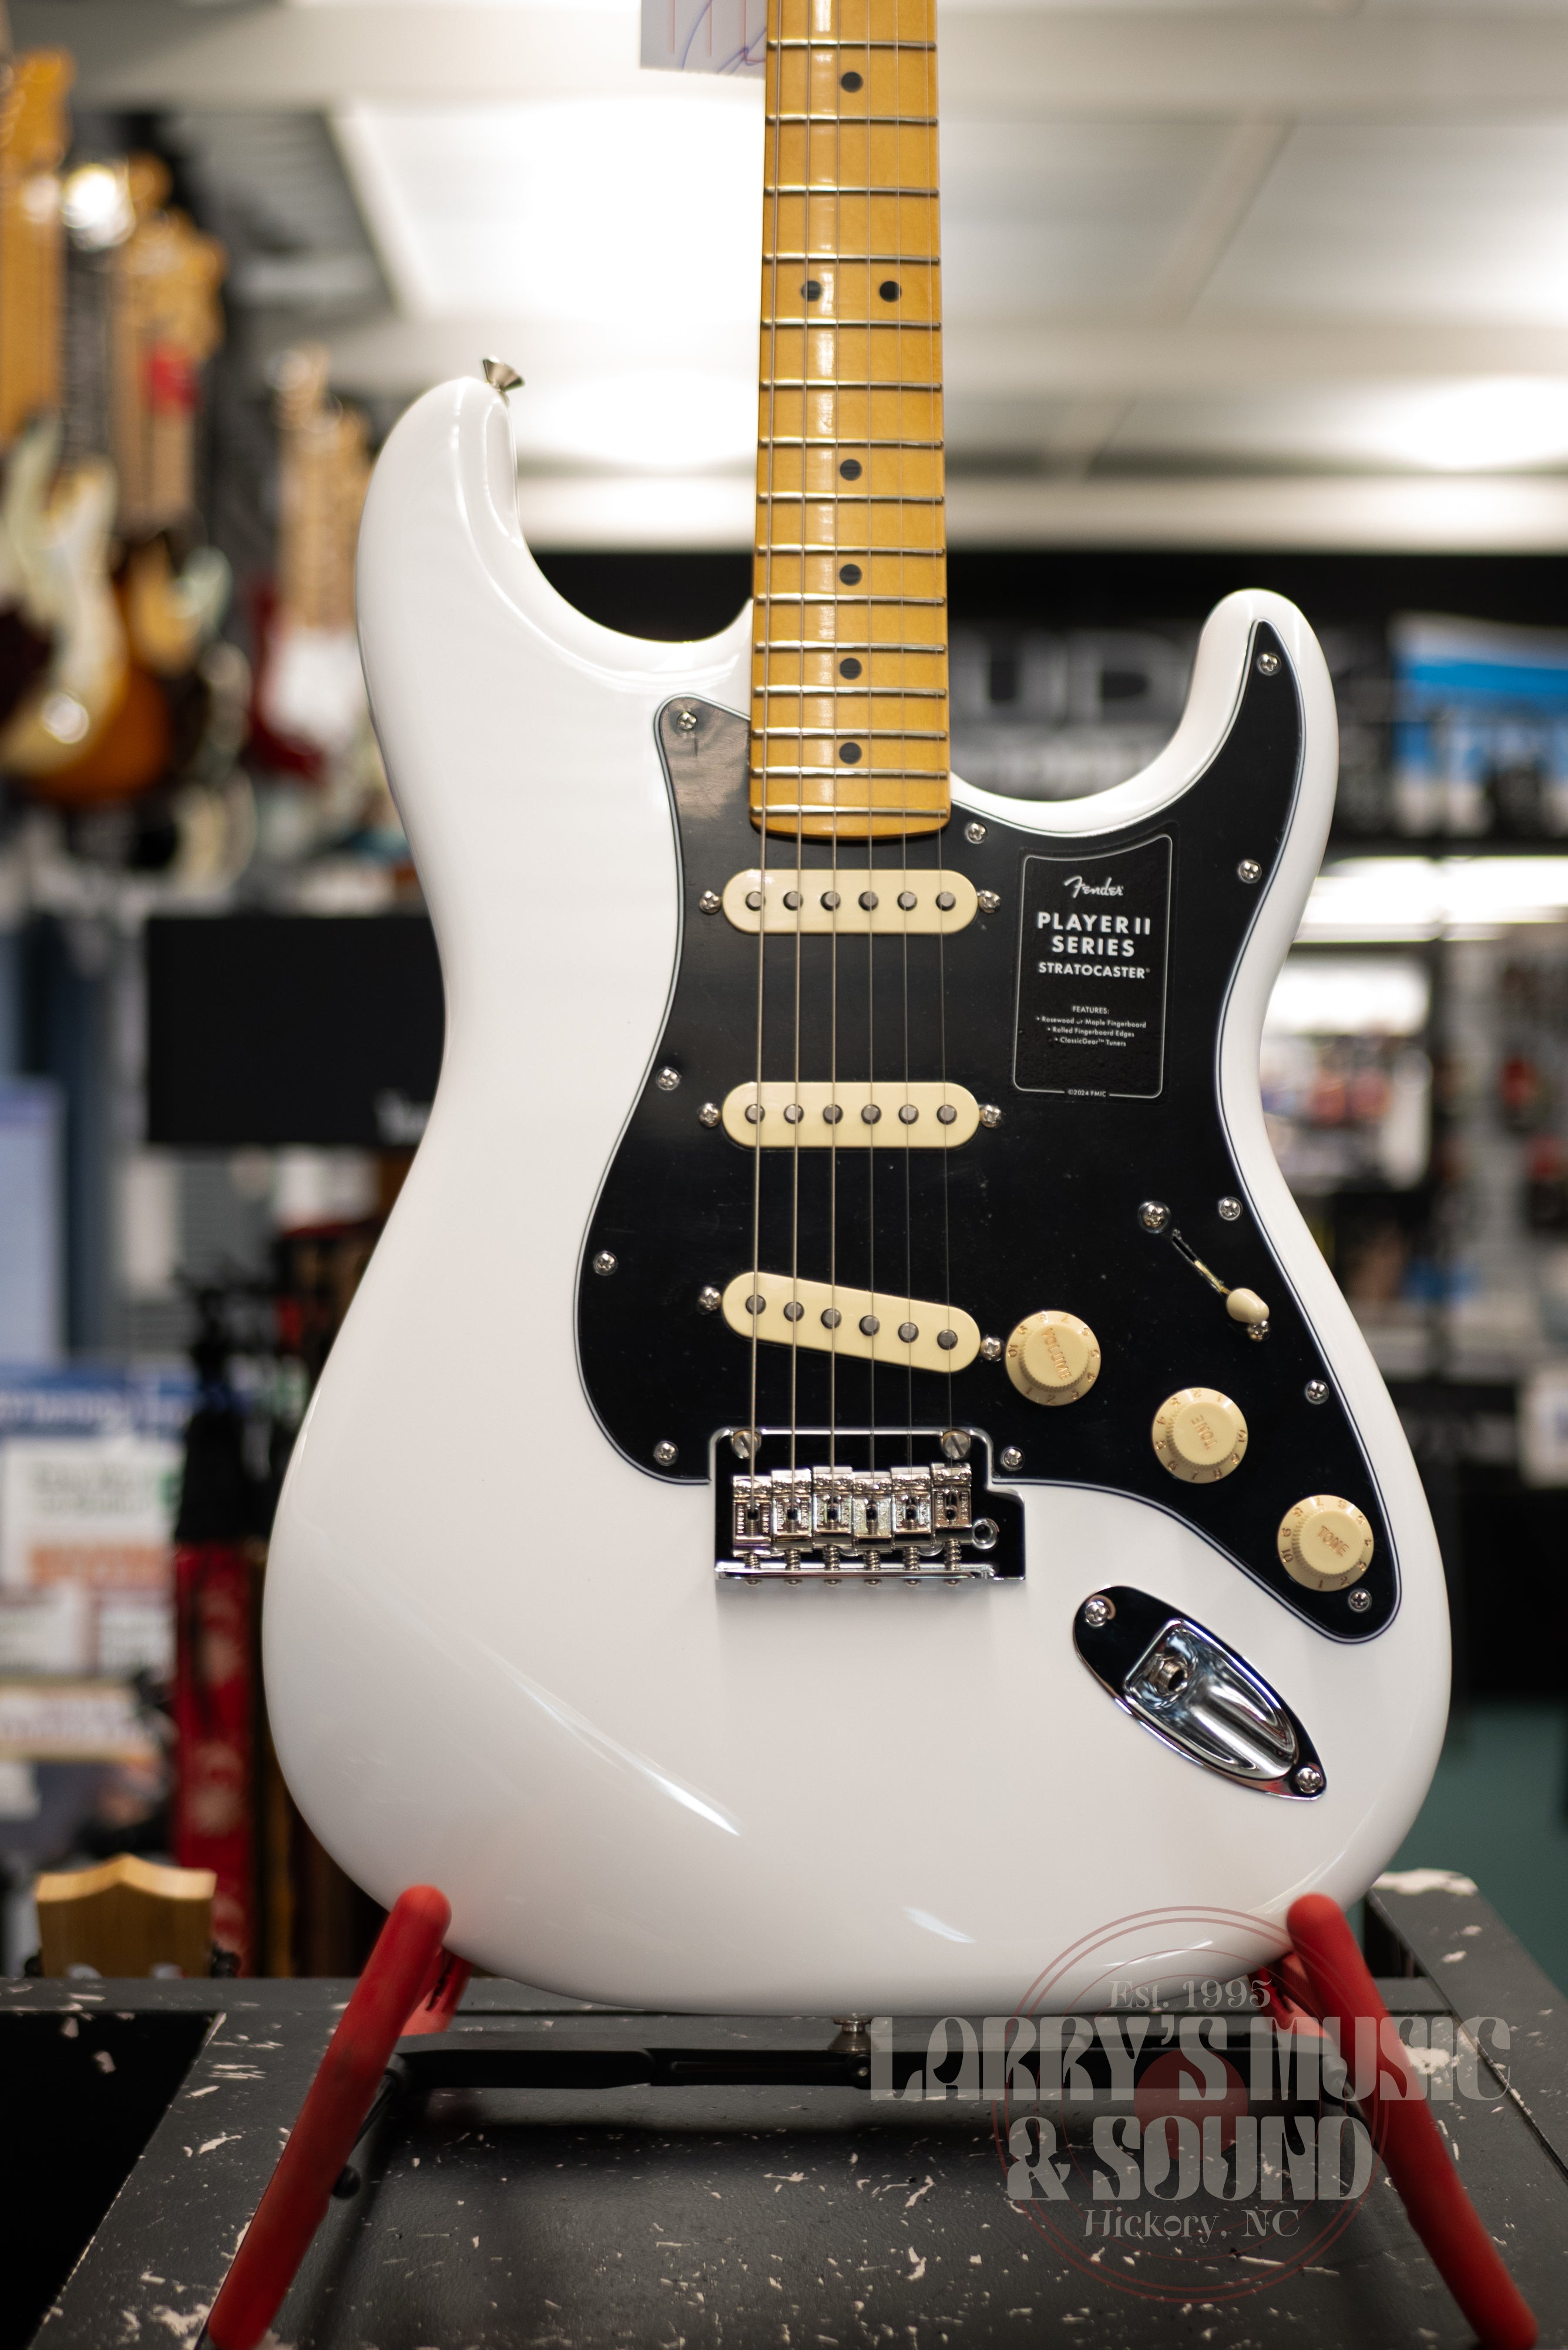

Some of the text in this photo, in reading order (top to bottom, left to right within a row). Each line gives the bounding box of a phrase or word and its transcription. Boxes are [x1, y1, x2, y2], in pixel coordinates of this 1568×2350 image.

[1064, 875, 1124, 898] Fender
[1038, 912, 1151, 935] PLAYER II
[1052, 935, 1134, 957] SERIES
[1072, 1005, 1110, 1015] FEATURES:
[1042, 1016, 1075, 1024] Rosewood
[1107, 1020, 1147, 1028] Fingerboard
[1075, 1028, 1114, 1036] Fingerboard
[1116, 1030, 1135, 1038] Edges
[1042, 1328, 1072, 1381] VOLUME
[1191, 1415, 1218, 1450] TONE
[1317, 1526, 1349, 1557] TONE
